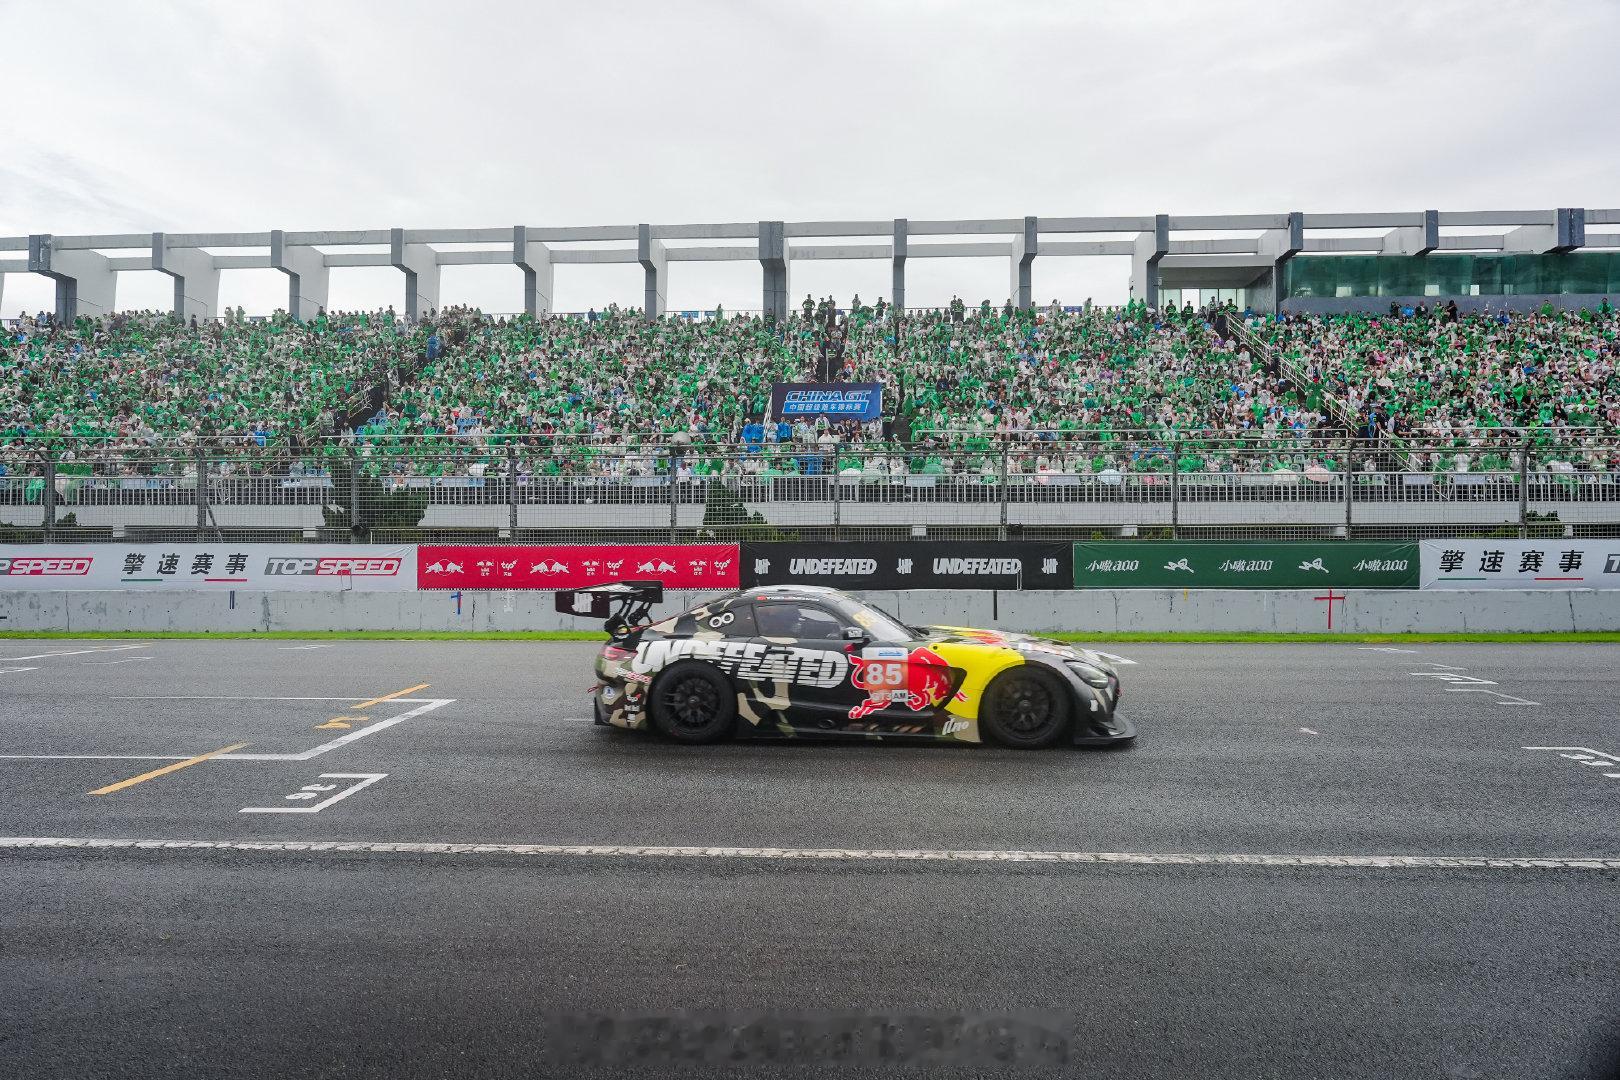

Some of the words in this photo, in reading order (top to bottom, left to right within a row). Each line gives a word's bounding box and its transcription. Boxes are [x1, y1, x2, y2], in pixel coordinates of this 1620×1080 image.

[785, 390, 843, 402] CHINA
[844, 390, 872, 401] GT
[121, 552, 249, 575] 擎速赛事
[789, 558, 877, 575] UNDEFEATED
[933, 558, 1021, 575] UNDEFEATED
[1439, 549, 1585, 573] 擎速赛事
[866, 663, 912, 685] 85
